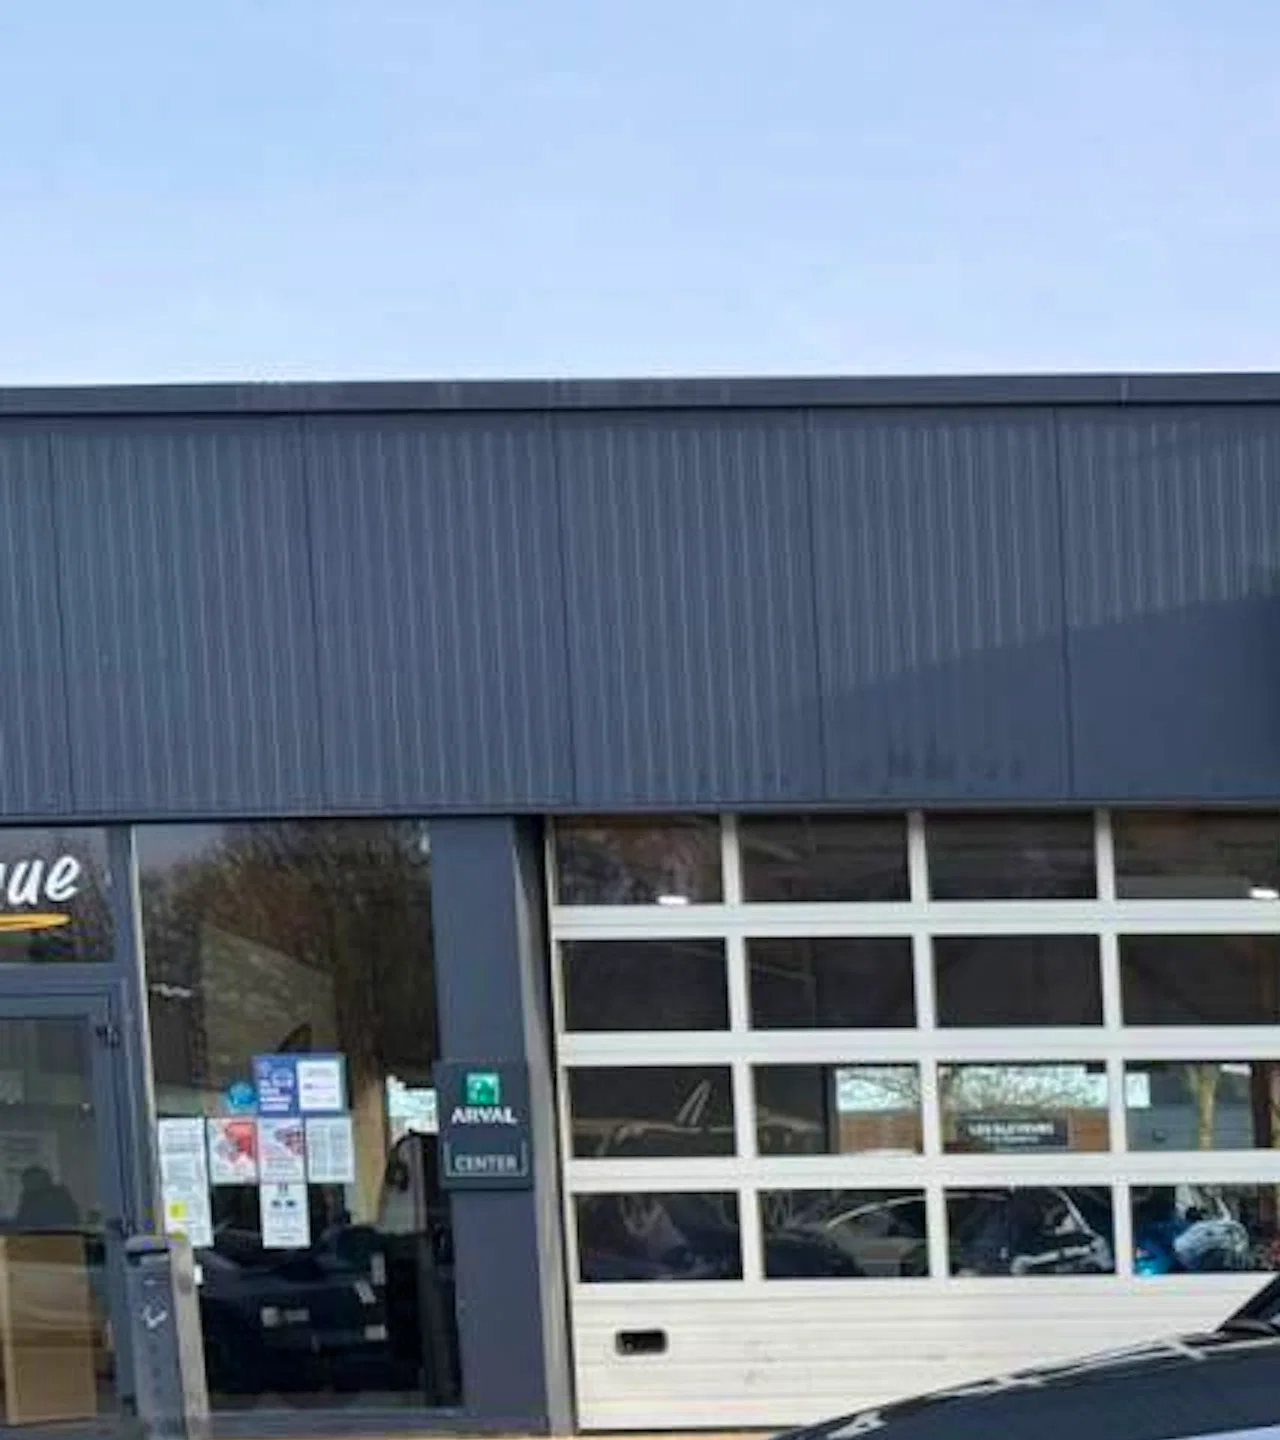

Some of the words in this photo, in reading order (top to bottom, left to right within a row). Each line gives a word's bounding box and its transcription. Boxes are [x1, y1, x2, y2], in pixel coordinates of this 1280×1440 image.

[0, 855, 81, 905] ue
[450, 1105, 519, 1125] ARVAL
[454, 1153, 519, 1173] CENTER
